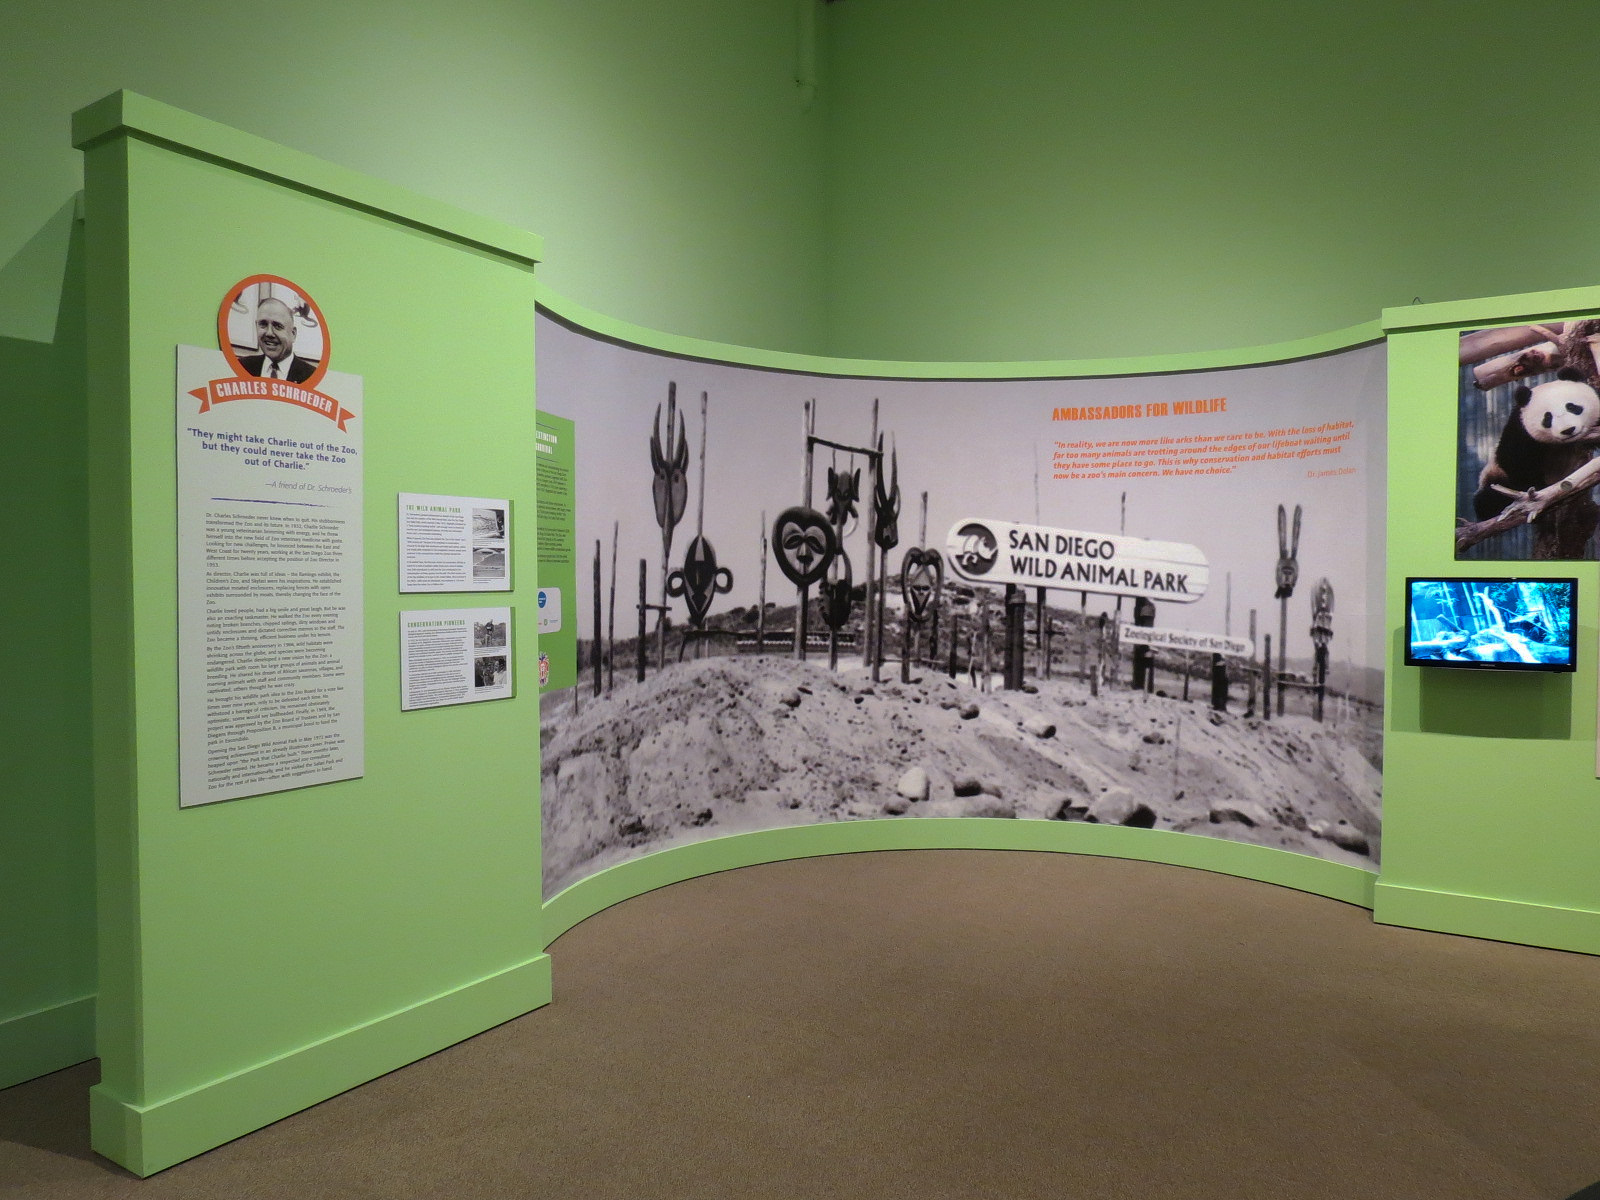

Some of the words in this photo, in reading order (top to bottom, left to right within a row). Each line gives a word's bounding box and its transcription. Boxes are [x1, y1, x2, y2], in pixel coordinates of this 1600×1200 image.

[217, 382, 267, 397] CHARLES
[271, 384, 332, 412] SCHROEDER
[1052, 405, 1142, 421] AMBASSADORS
[1146, 402, 1168, 417] FOR
[1173, 398, 1226, 415] WILDLIFE
[217, 432, 242, 443] might
[245, 435, 264, 444] take
[267, 437, 297, 447] Charlie
[316, 442, 324, 451] of
[326, 444, 339, 452] the
[342, 445, 357, 455] Zoo,
[1053, 451, 1064, 460] far
[1080, 452, 1101, 460] many
[1102, 449, 1132, 457] animals
[1147, 448, 1178, 456] trotting
[1180, 445, 1208, 454] around
[1223, 444, 1246, 453] edges
[1248, 442, 1256, 452] of
[1272, 439, 1302, 450] lifeboat
[1304, 436, 1332, 445] waiting
[1333, 431, 1350, 441] until
[1066, 440, 1093, 449] reality,
[1175, 436, 1192, 444] arks
[1194, 435, 1212, 443] than
[1254, 431, 1265, 439] be.
[1268, 429, 1286, 437] With
[1287, 427, 1300, 435] the
[1301, 426, 1316, 434] loss
[1317, 424, 1325, 434] of
[1326, 421, 1354, 430] habitat,
[202, 441, 217, 450] but
[220, 443, 240, 455] they
[243, 447, 267, 455] could
[270, 450, 293, 458] never
[296, 451, 314, 460] take
[316, 453, 329, 461] the
[332, 454, 346, 463] Zoo
[244, 458, 259, 466] out
[1053, 462, 1071, 470] they
[1072, 461, 1090, 469] have
[1111, 460, 1132, 469] place
[1143, 460, 1155, 468] go.
[1158, 458, 1173, 466] This
[1182, 457, 1199, 466] why
[1200, 455, 1250, 464] conservation
[1251, 452, 1266, 461] and
[1267, 451, 1295, 459] habitat
[1297, 449, 1321, 459] efforts
[1323, 446, 1341, 455] must
[1070, 471, 1080, 479] be
[1087, 471, 1106, 479] zoo's
[1107, 470, 1126, 478] main
[1175, 468, 1193, 476] have
[1009, 530, 1049, 551] SAN
[1056, 536, 1114, 559] DIEGO
[1011, 556, 1057, 578] WILD
[1061, 563, 1137, 587] ANIMAL
[1144, 570, 1187, 593] PARK
